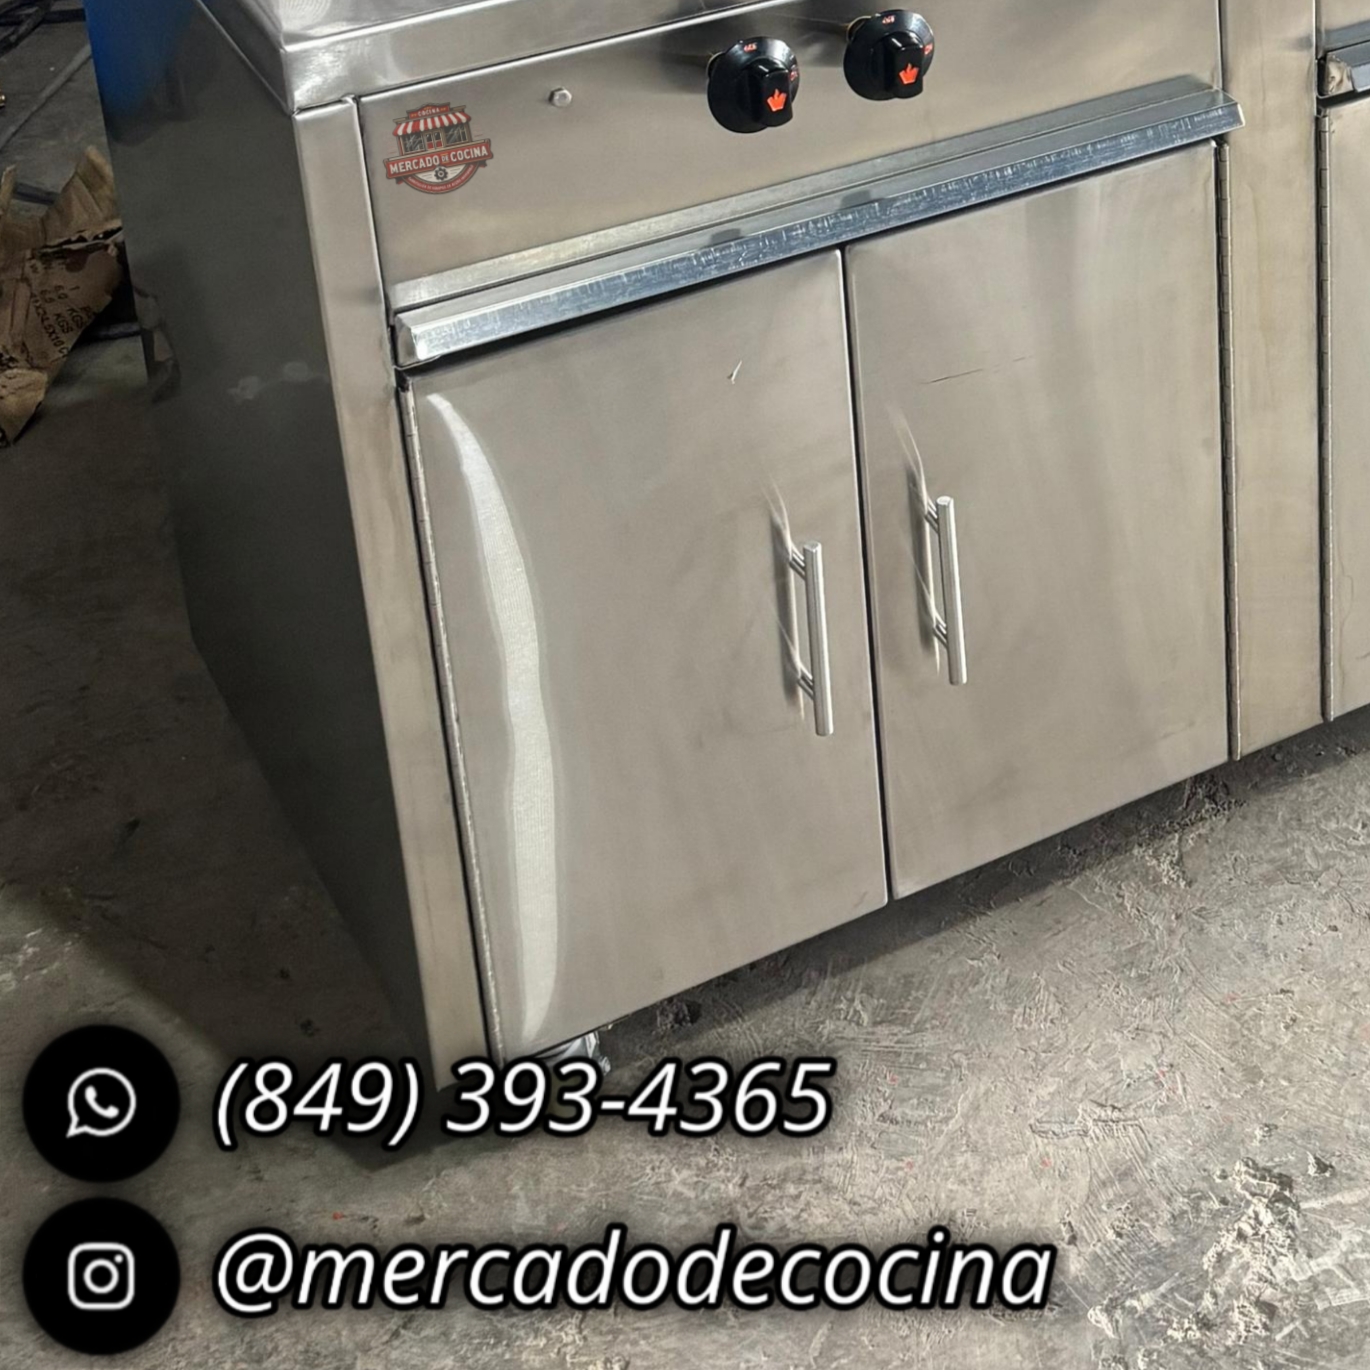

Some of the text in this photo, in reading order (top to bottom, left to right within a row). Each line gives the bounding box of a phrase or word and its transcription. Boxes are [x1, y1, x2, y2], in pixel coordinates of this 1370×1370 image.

[417, 107, 441, 117] COCINA
[389, 146, 488, 175] MERCADO DE COCINA
